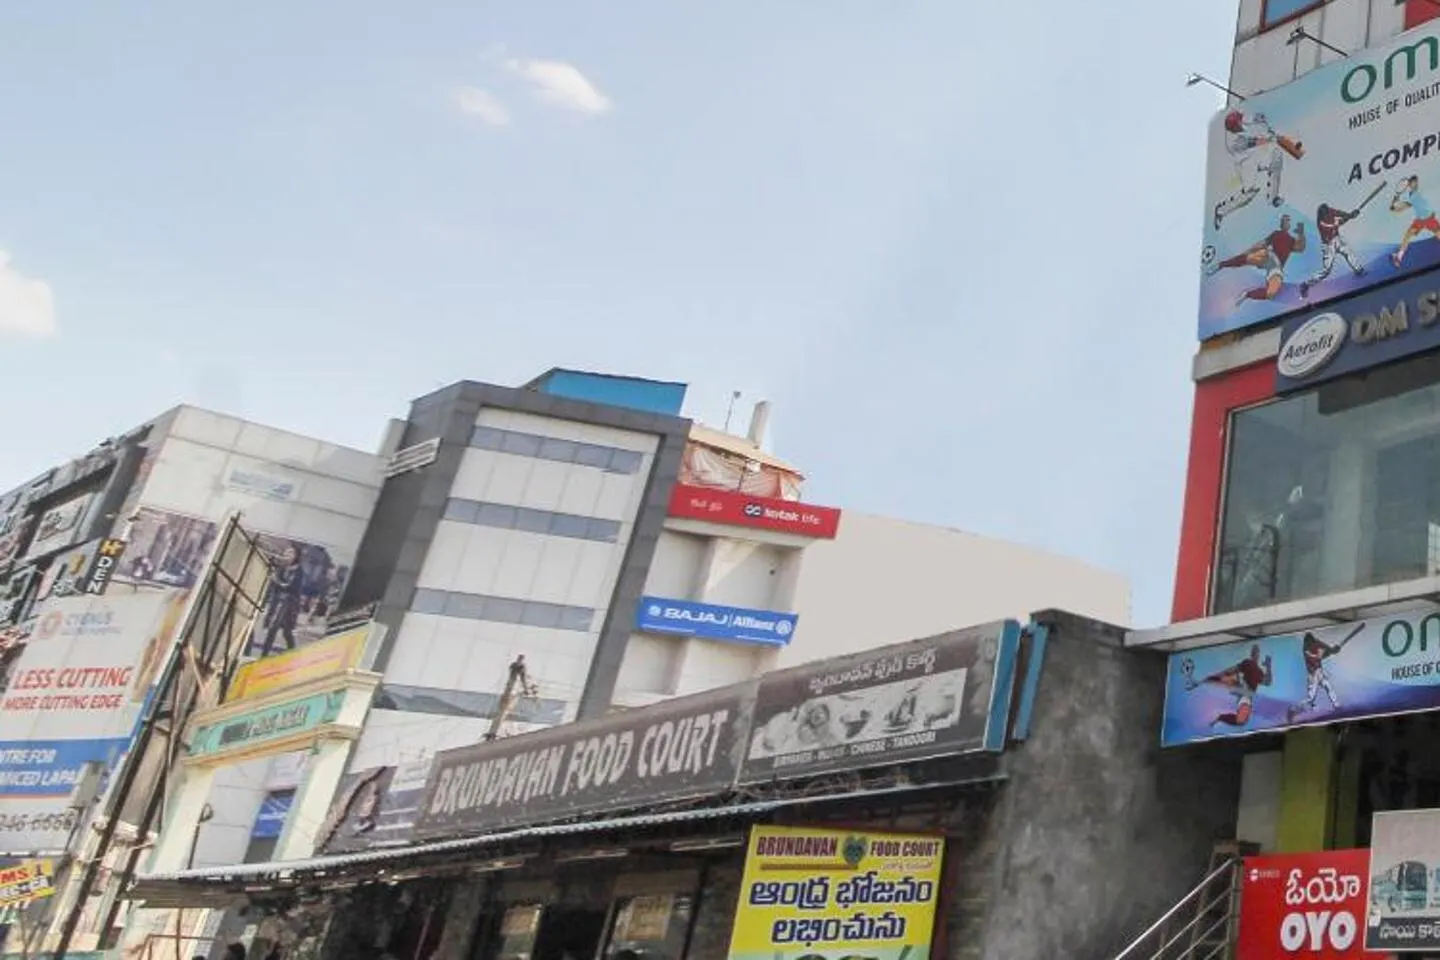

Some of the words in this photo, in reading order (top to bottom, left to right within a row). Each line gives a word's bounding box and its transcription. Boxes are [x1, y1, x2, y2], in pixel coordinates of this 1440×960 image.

[1348, 106, 1382, 130] HOUSE
[1386, 100, 1401, 115] OF
[1347, 163, 1362, 184] A
[1352, 300, 1409, 343] OM
[1282, 332, 1336, 363] Aerofit
[663, 607, 728, 625] BAJAJ
[12, 668, 56, 690] LESS
[57, 666, 134, 689] CUTTING
[1391, 662, 1422, 681] HOUSE
[1422, 661, 1434, 677] OF
[3, 696, 38, 710] MORE
[38, 695, 89, 709] CUTTING
[89, 694, 124, 708] EDGE
[430, 744, 567, 816] BRUNDAVAN
[561, 729, 635, 796] FOOD
[636, 709, 729, 778] COURT
[755, 836, 838, 857] BRUNDAVAN
[870, 841, 899, 857] FOOD
[902, 841, 940, 857] COURT
[835, 871, 934, 909] భోజనం
[1285, 866, 1361, 905] ఓయో
[771, 911, 907, 947] లభించును
[1279, 910, 1358, 952] OYO
